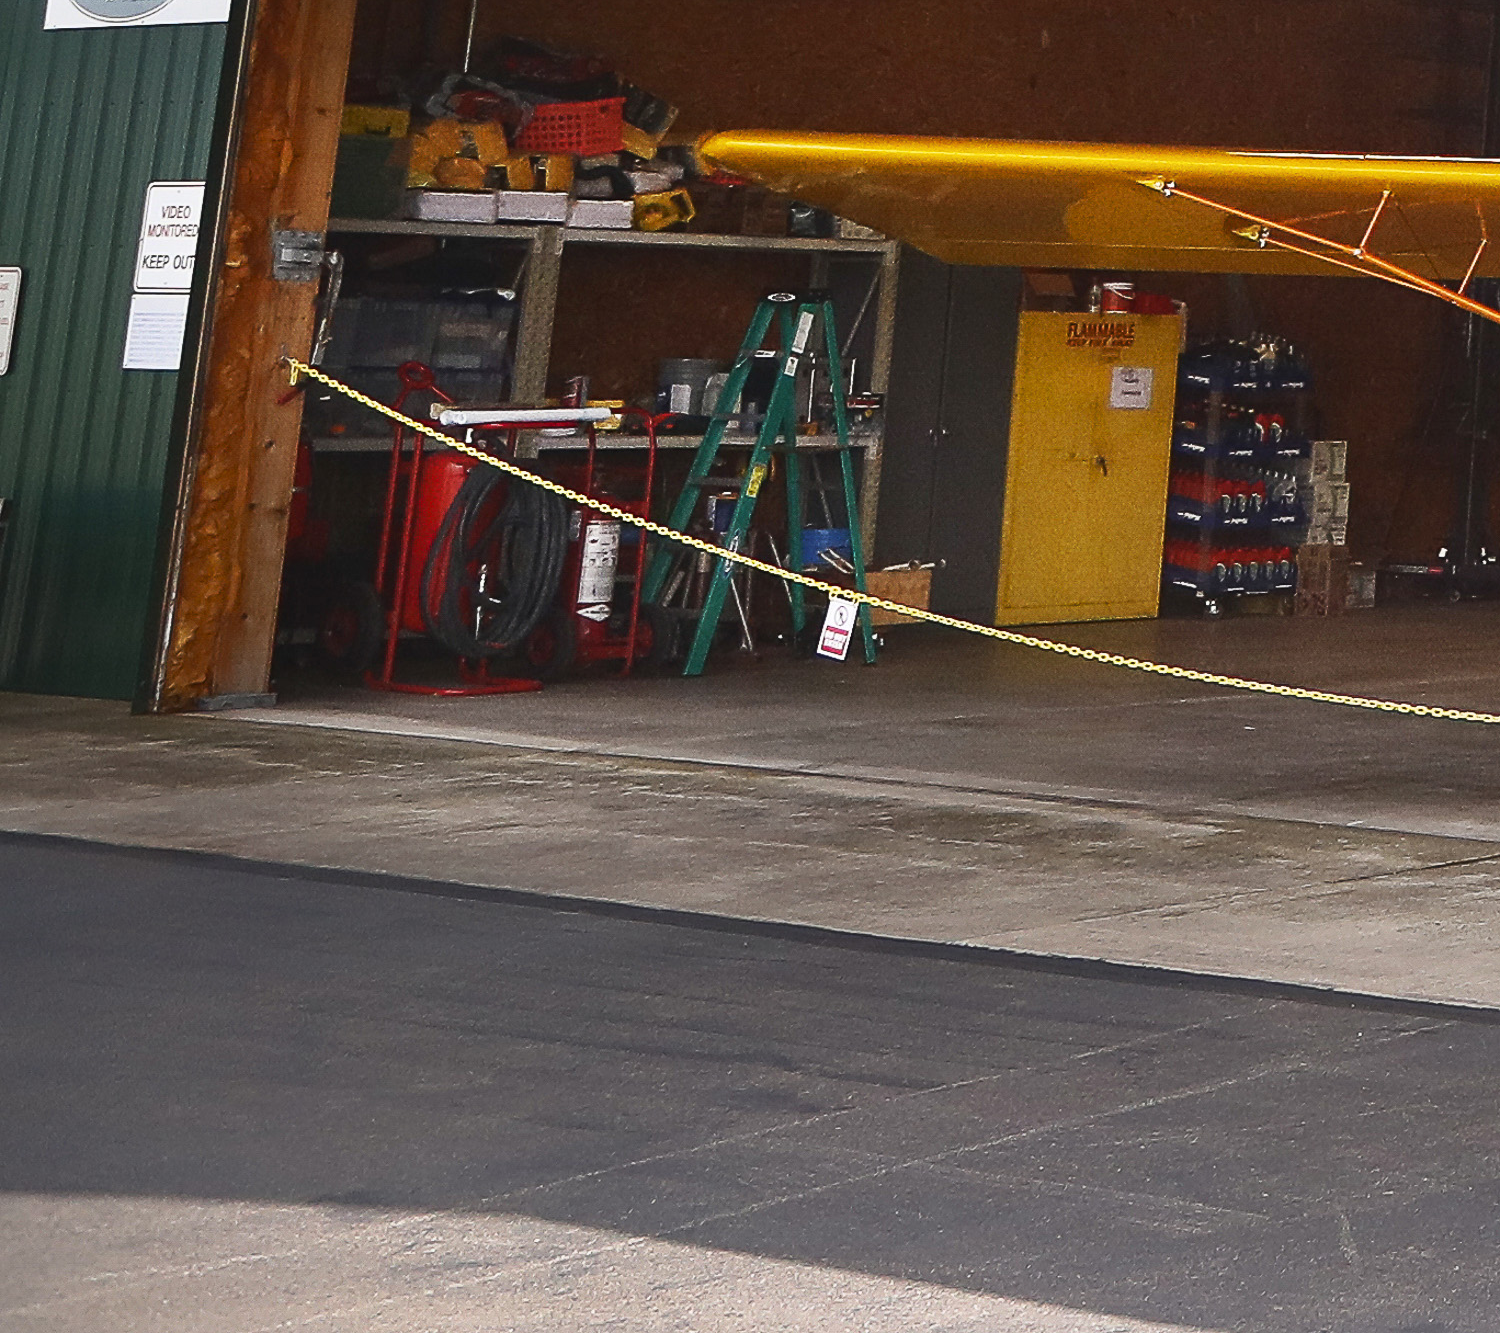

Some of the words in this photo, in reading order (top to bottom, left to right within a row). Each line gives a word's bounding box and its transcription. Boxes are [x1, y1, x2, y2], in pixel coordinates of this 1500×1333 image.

[161, 205, 191, 219] VIDEO
[147, 224, 199, 238] MONITORED
[142, 255, 170, 269] KEEP
[173, 254, 196, 269] OUT
[1066, 322, 1135, 338] FLAMMABLE
